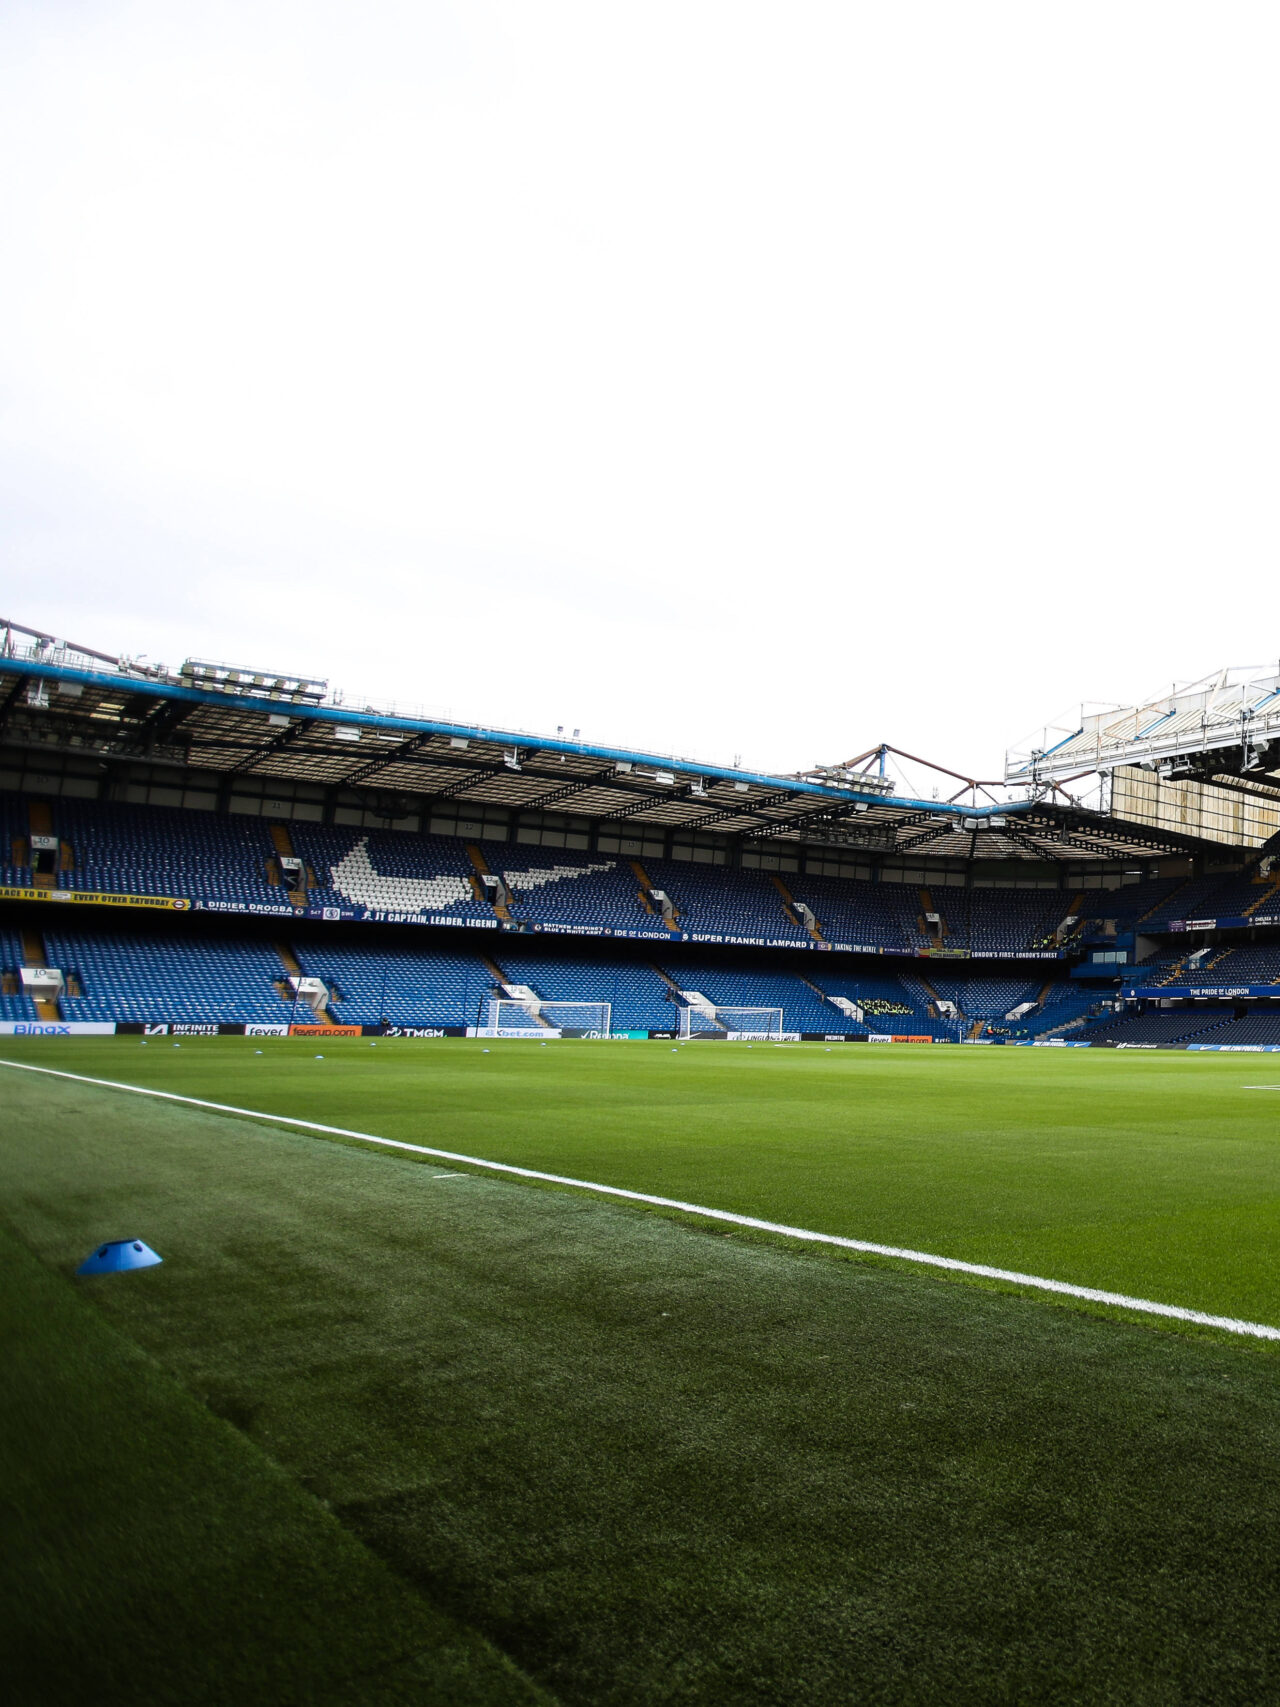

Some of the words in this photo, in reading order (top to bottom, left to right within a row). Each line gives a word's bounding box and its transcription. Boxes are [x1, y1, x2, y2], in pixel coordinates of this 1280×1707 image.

[74, 894, 99, 902] EVERY
[102, 895, 127, 903] OTHER
[130, 897, 169, 906] SATURDAY
[208, 901, 246, 910] DIDIER
[249, 903, 293, 912] DROGBA
[375, 912, 385, 921] JT
[388, 913, 429, 925] CAPTAIN,
[430, 916, 465, 927] LEADER,
[466, 918, 497, 928] LEGEND
[638, 931, 671, 939] LONDON
[692, 934, 723, 943] SUPER
[725, 936, 764, 946] FRANKIE
[767, 939, 807, 948] LAMPARD
[835, 943, 852, 952] TAKING
[1225, 988, 1249, 996] LONDON
[250, 1026, 283, 1036] fever
[293, 1026, 355, 1036] feverup.com
[404, 1029, 444, 1037] TMGM
